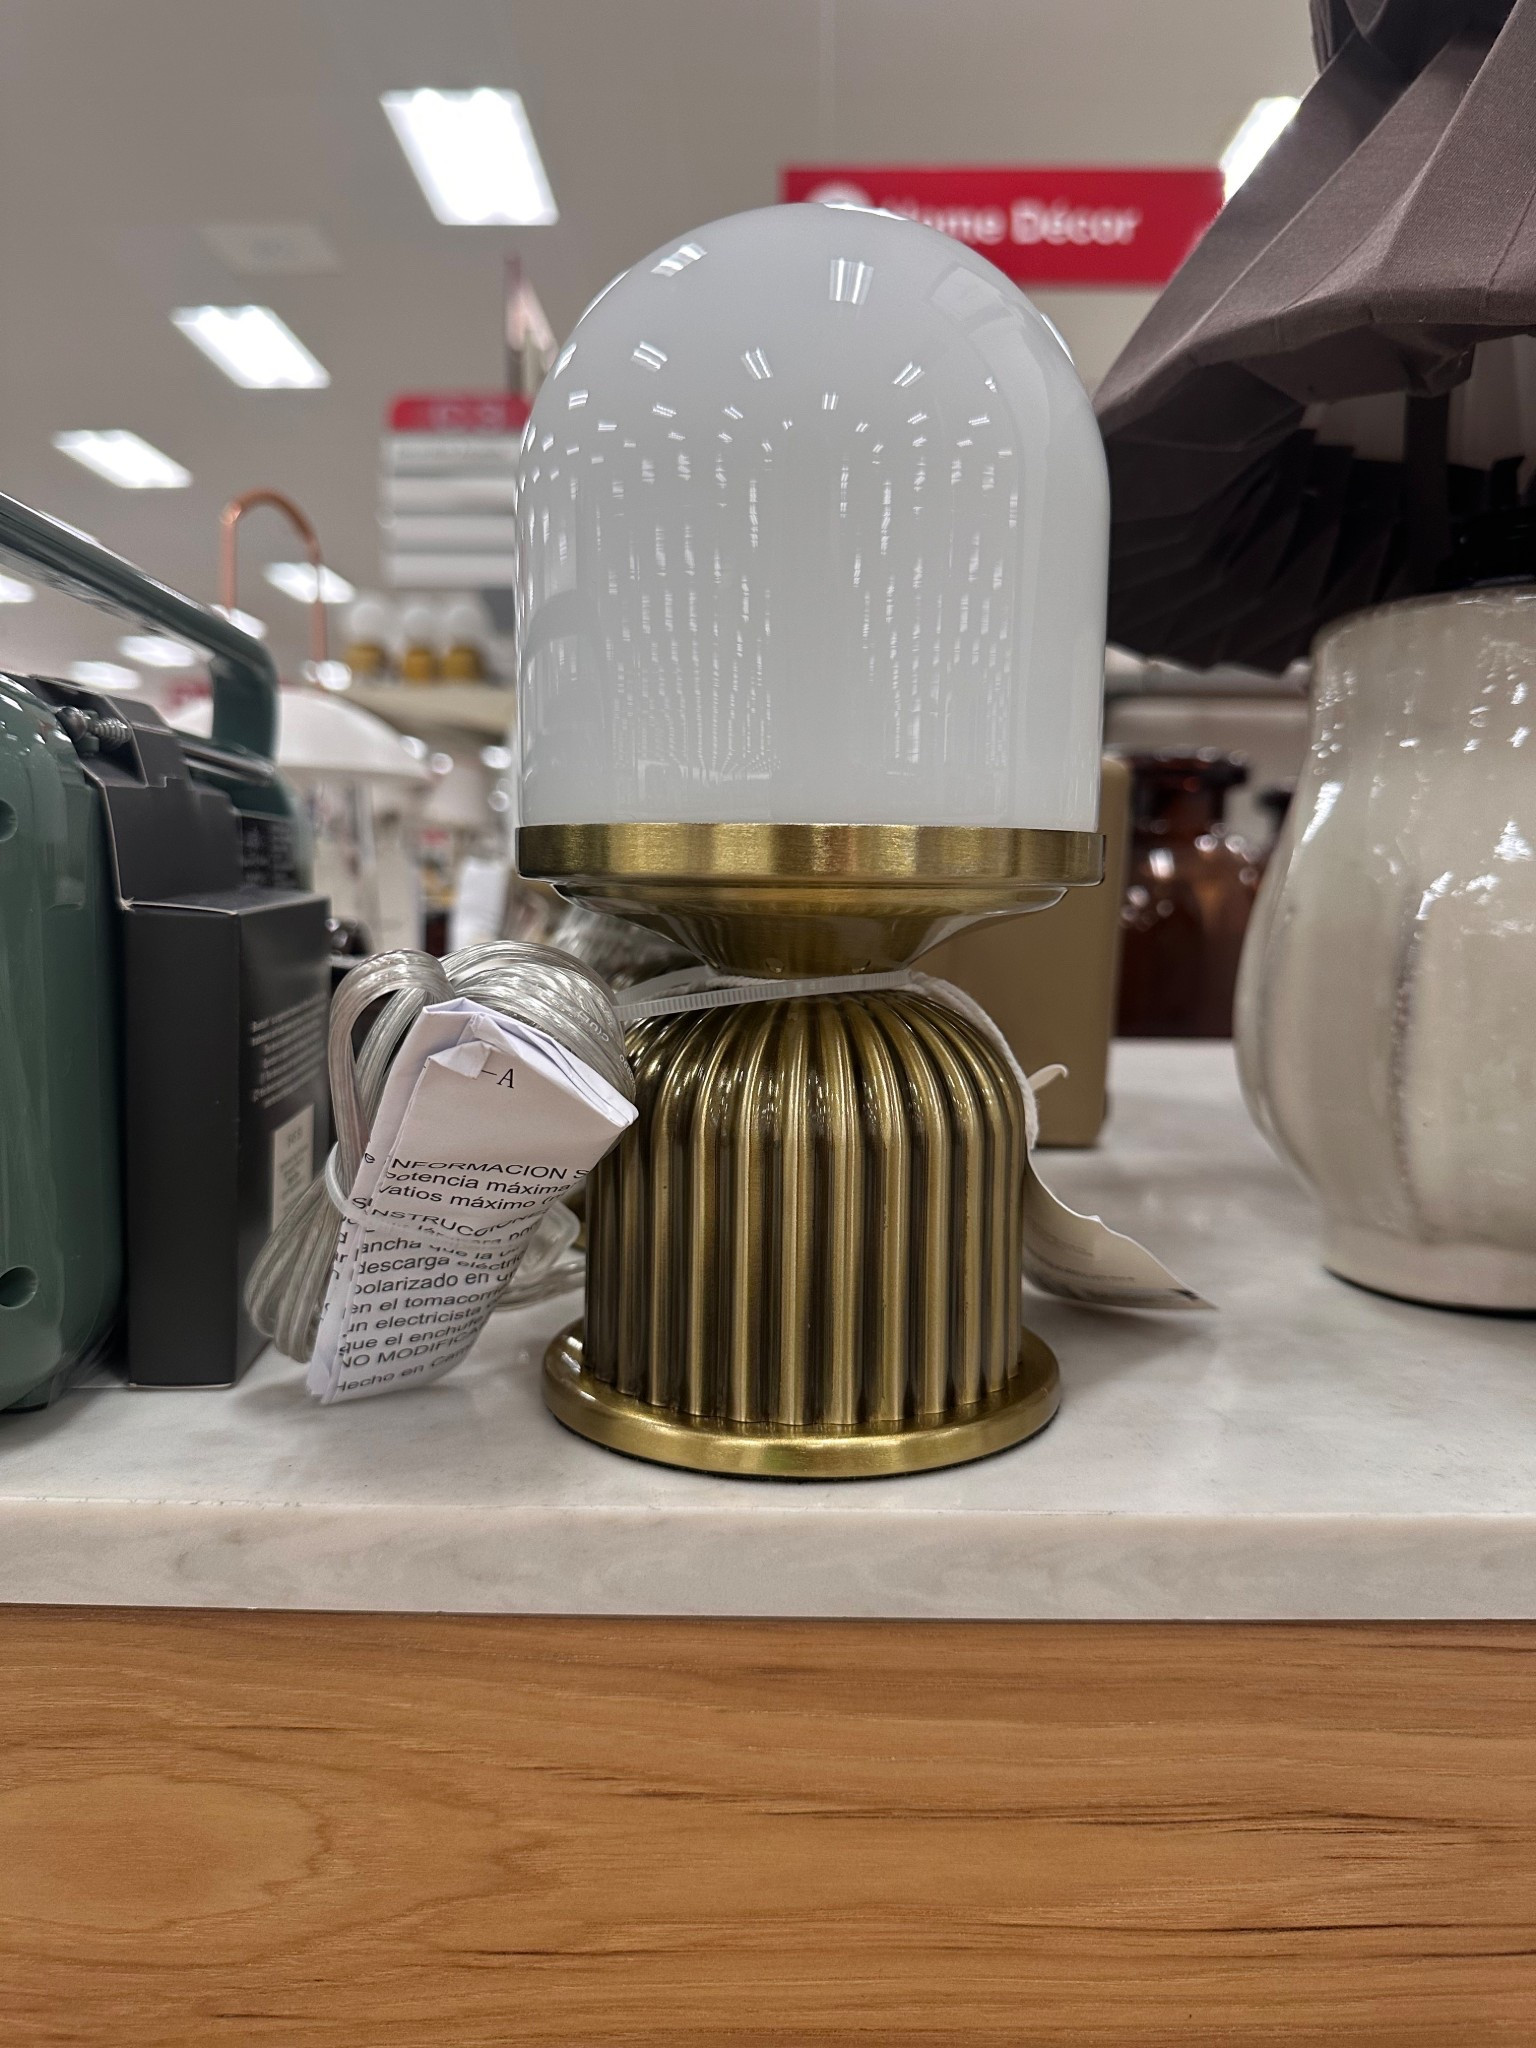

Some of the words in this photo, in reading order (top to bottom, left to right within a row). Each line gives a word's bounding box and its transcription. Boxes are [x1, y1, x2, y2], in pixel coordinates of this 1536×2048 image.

[1009, 197, 1143, 246] Décor
[496, 1068, 514, 1089] A
[386, 1158, 568, 1180] NFORMACION
[449, 1195, 536, 1211] máximo
[465, 1272, 490, 1285] en
[379, 1297, 399, 1312] el
[384, 1332, 403, 1346] el
